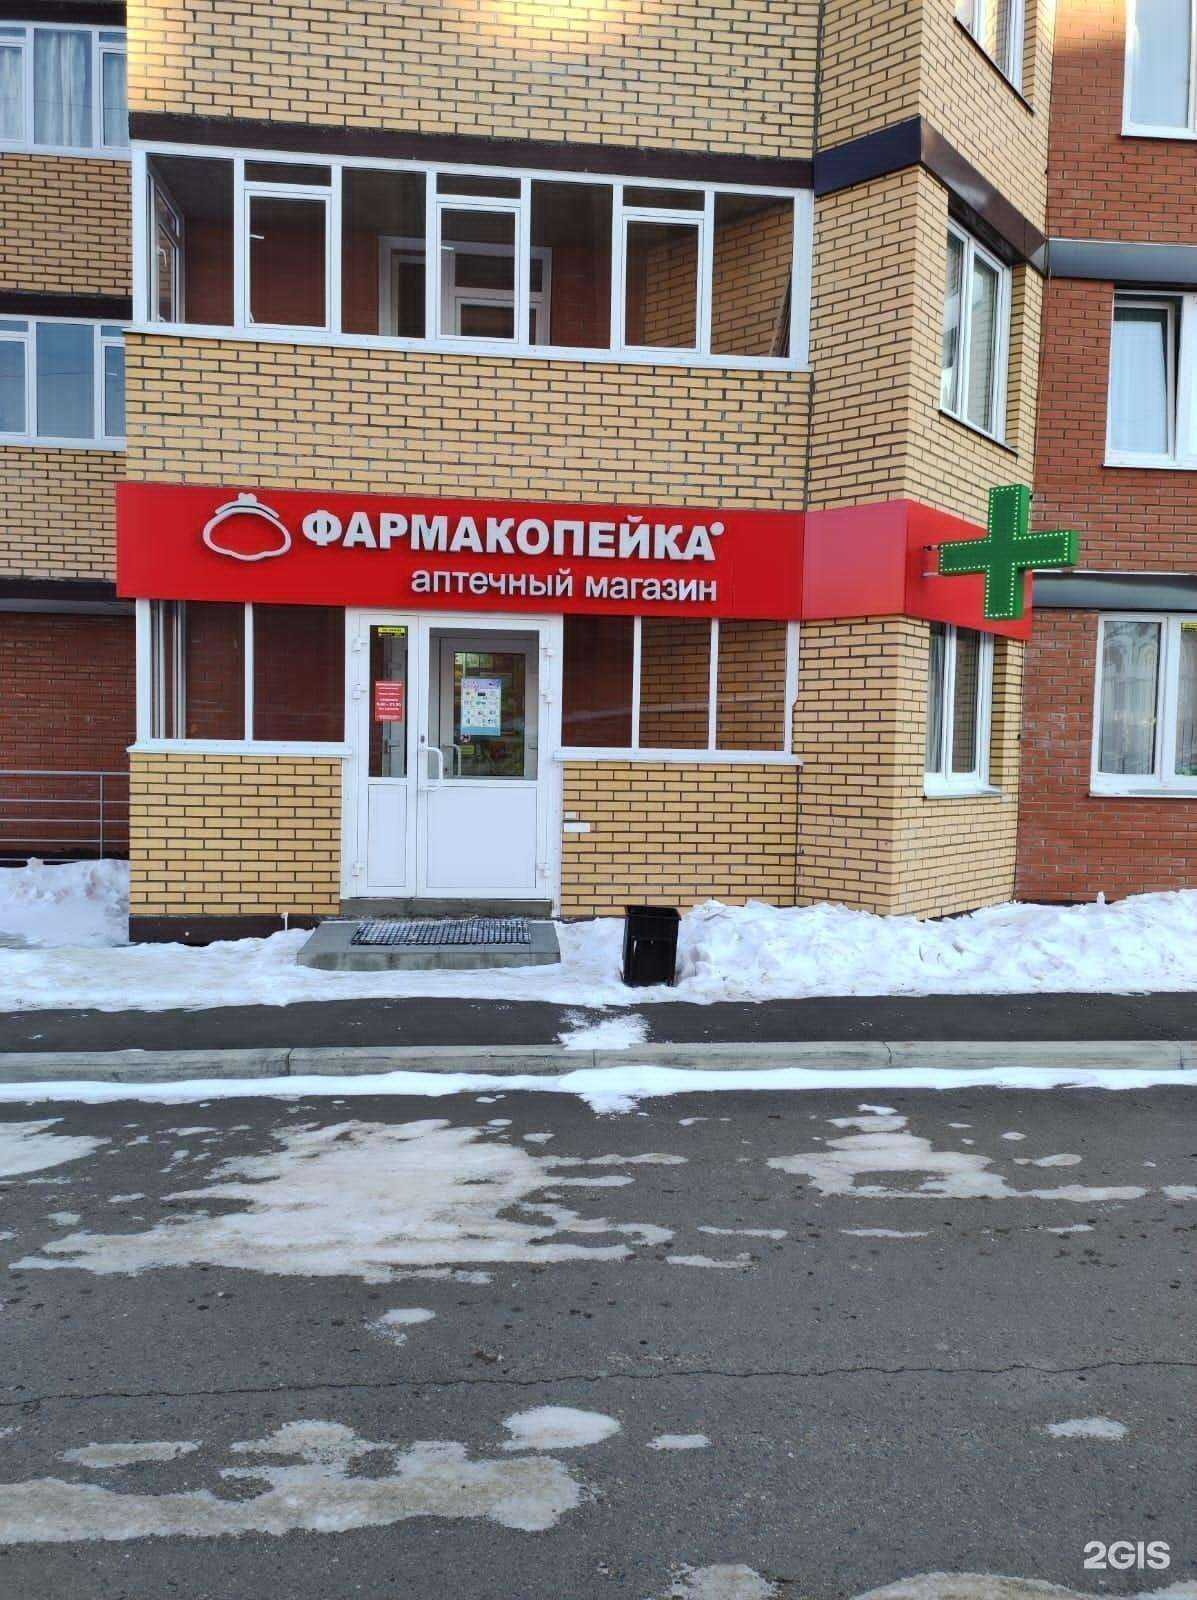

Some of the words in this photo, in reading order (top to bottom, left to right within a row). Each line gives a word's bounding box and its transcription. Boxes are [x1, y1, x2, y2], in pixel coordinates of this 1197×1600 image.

[302, 510, 717, 561] ФАРМАКОПЕЙКА
[411, 569, 573, 597] аптечный
[585, 576, 717, 601] магазин
